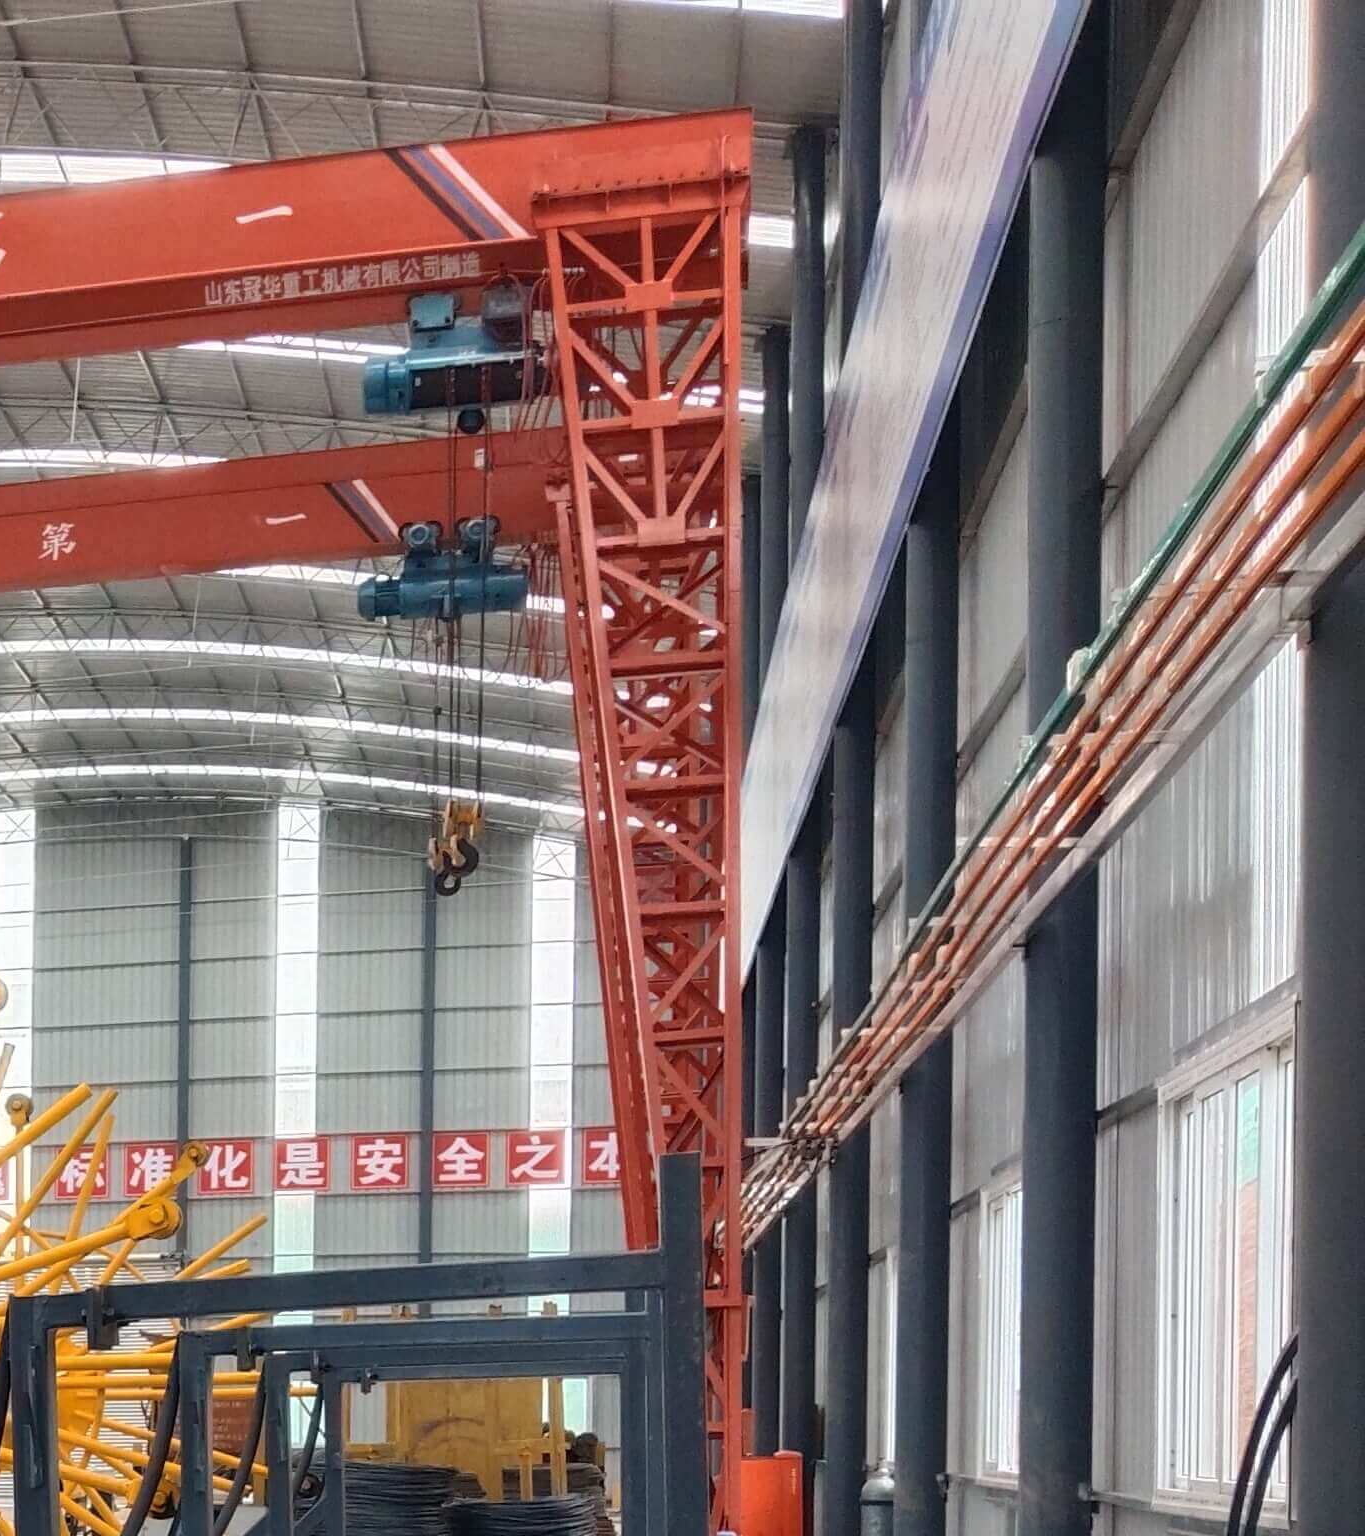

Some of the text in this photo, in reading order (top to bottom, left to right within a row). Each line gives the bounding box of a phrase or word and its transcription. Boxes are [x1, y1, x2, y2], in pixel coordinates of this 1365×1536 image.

[204, 251, 481, 306] 山东冠华重工机械有限公司制造
